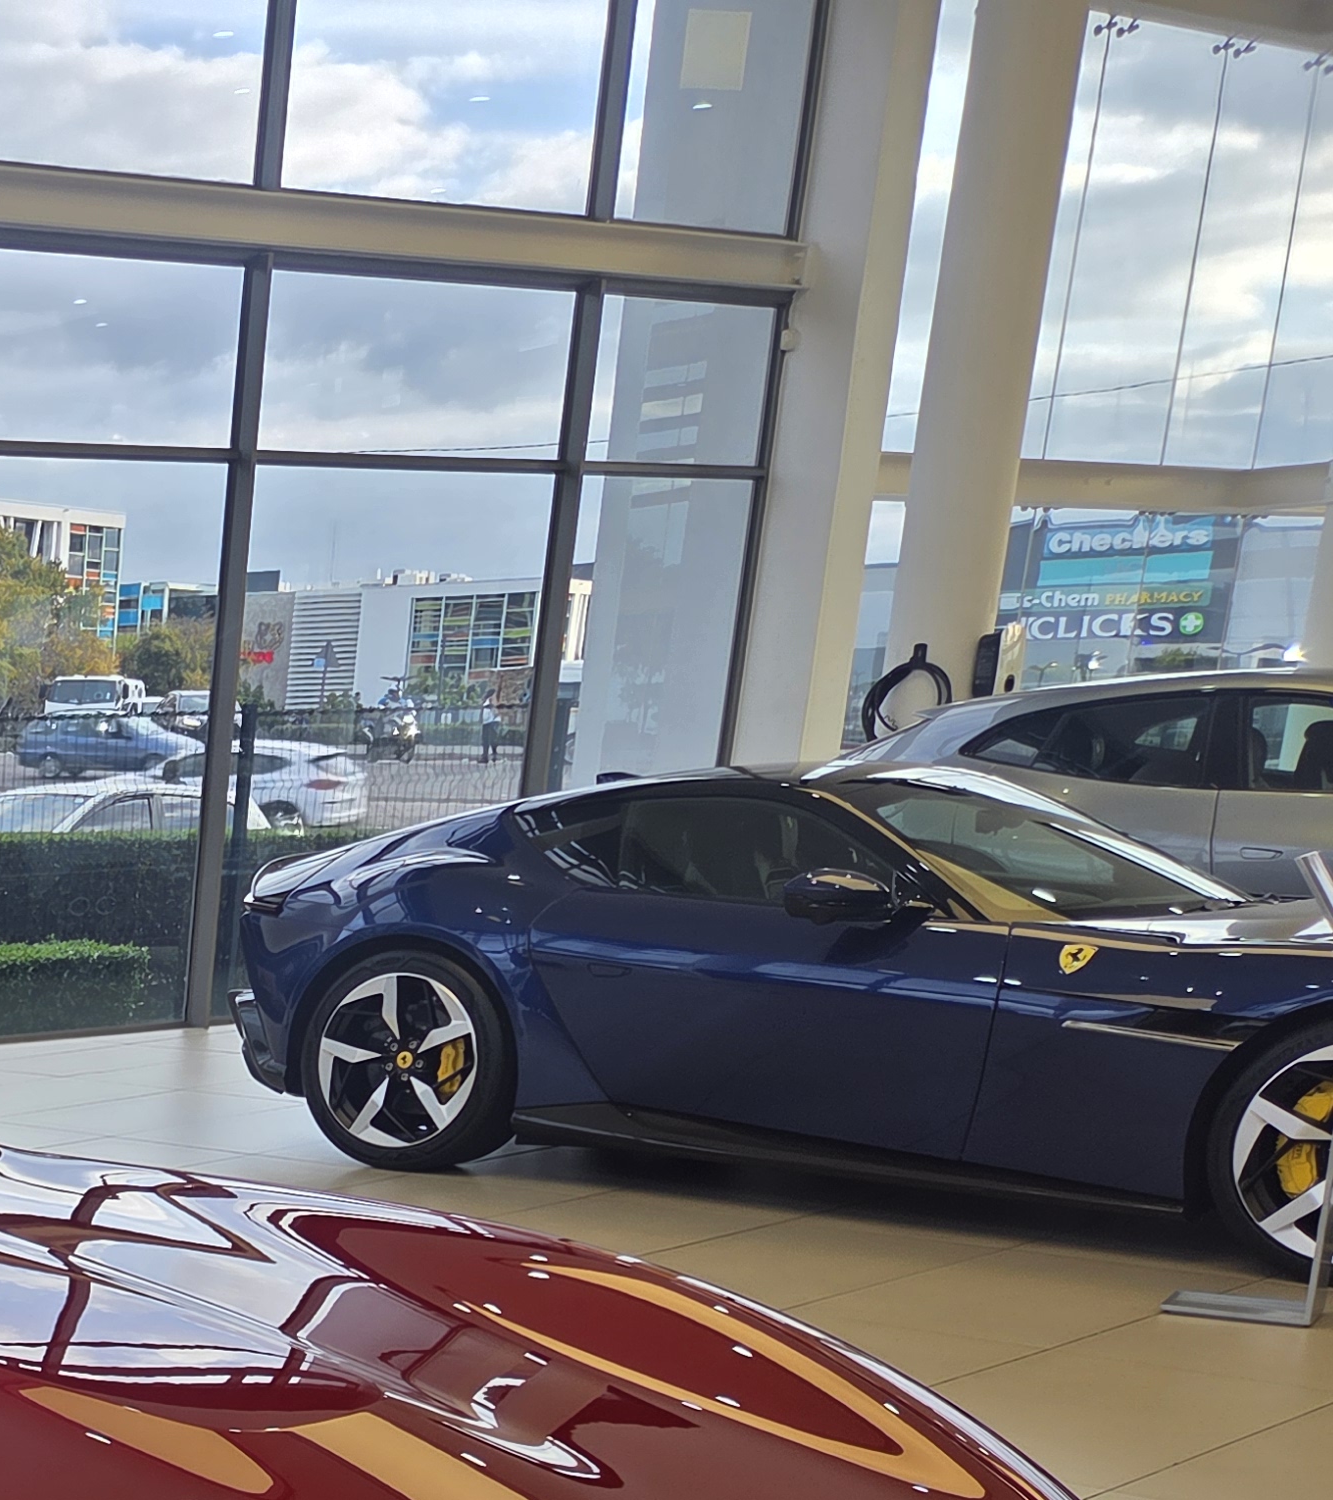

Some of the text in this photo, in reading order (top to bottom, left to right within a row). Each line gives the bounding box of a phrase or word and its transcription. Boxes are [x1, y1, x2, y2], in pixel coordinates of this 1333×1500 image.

[1000, 589, 1204, 610] s-Chem PHARMACY
[1029, 611, 1175, 641] CLICKS
